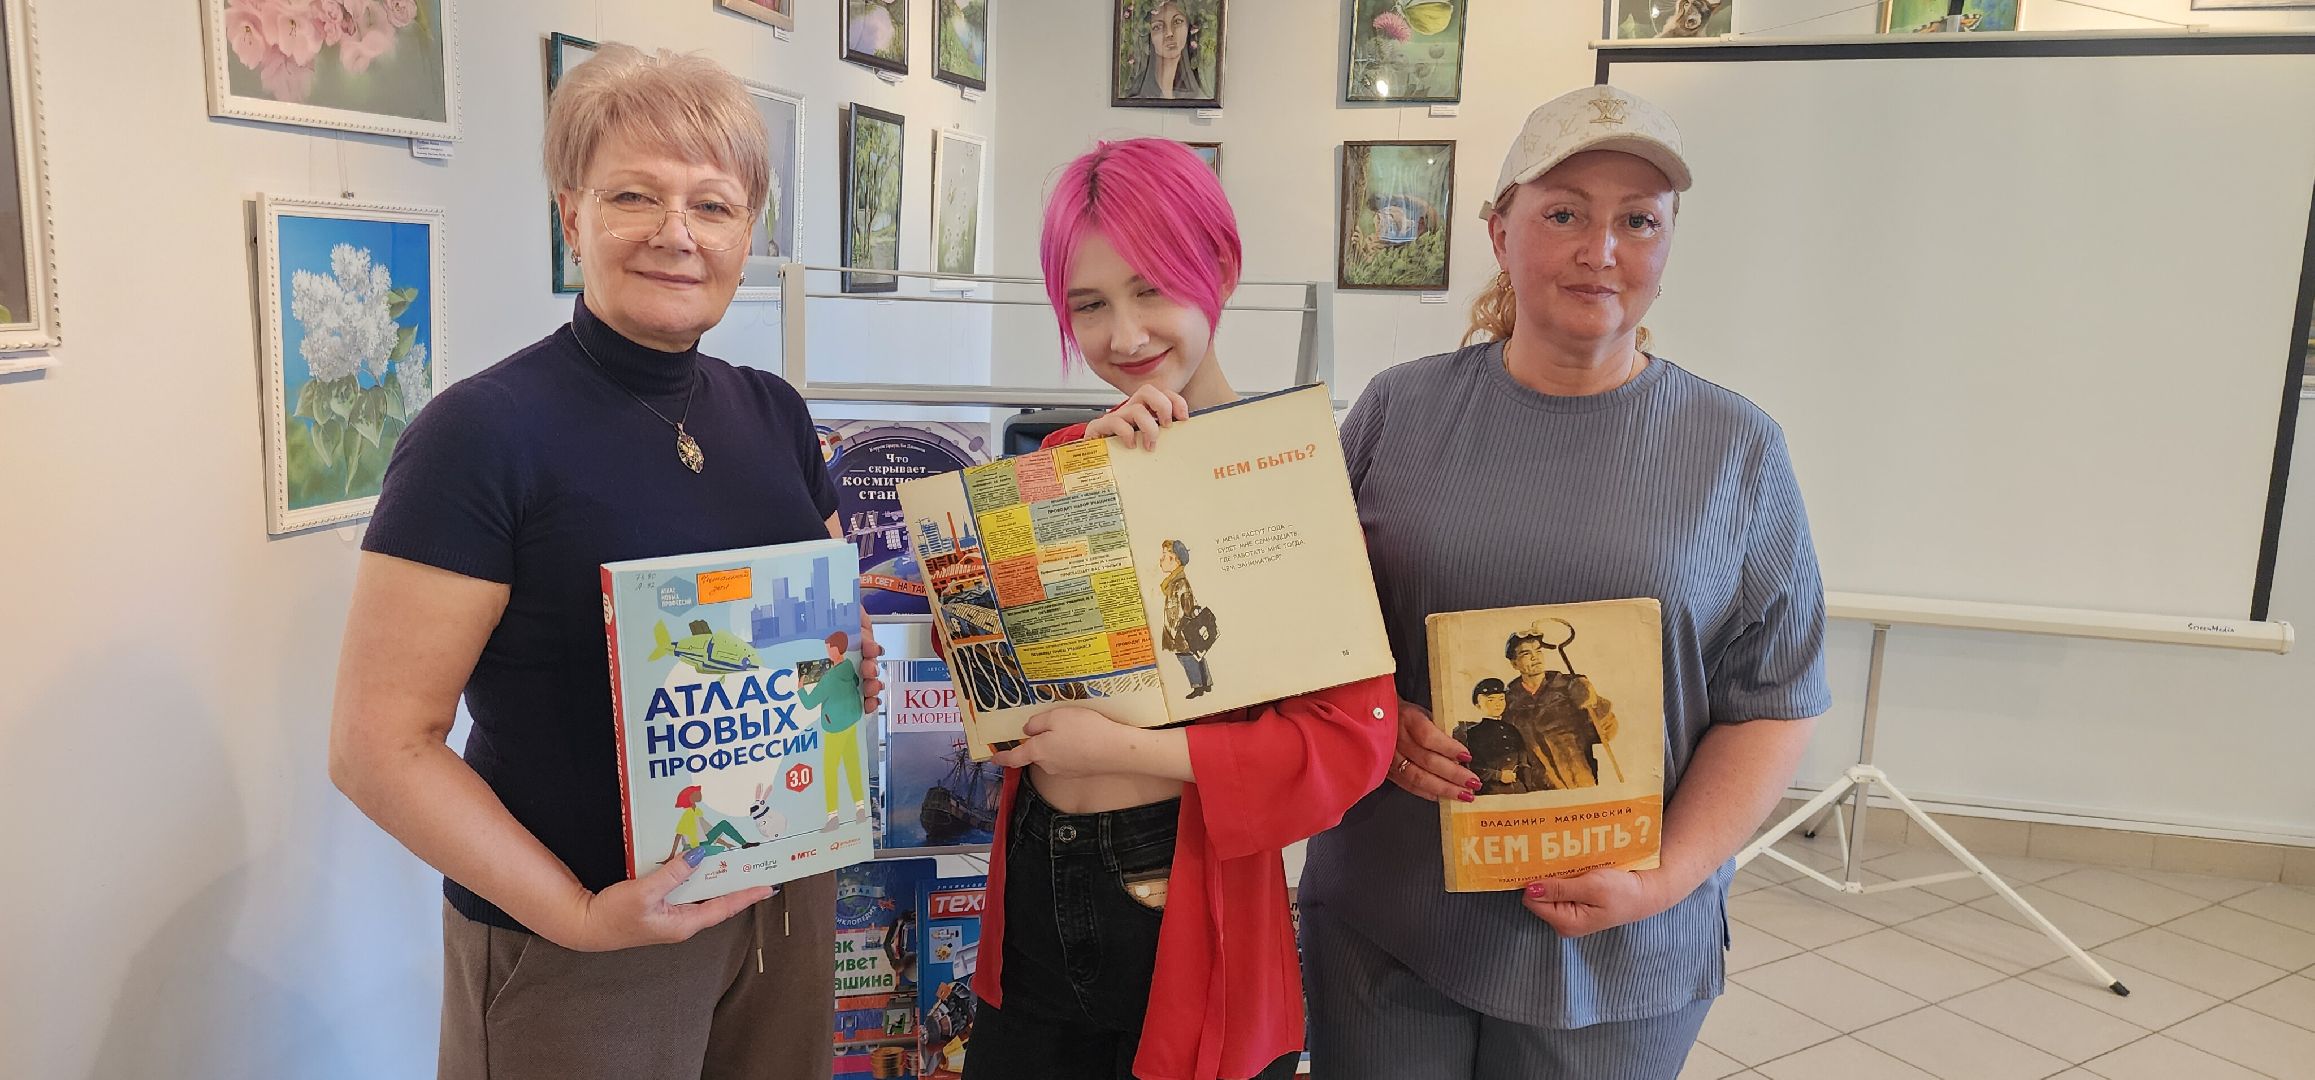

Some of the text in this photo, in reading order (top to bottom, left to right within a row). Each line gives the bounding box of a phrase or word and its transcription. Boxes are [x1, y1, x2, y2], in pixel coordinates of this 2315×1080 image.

[886, 453, 909, 463] Что
[1257, 443, 1316, 470] БЫТЬ?
[868, 465, 926, 475] скрывает
[842, 476, 920, 486] космиче
[859, 490, 900, 500] стан
[1268, 524, 1285, 532] ГОДА
[875, 577, 895, 587] СВЕТ
[897, 581, 908, 590] НА
[644, 668, 795, 721] АТЛАС
[904, 689, 959, 708] КОР
[897, 712, 963, 724] И МОРЕП
[646, 703, 799, 754] НОВЫХ
[649, 728, 818, 779] ПРОФЕССИЙ
[789, 768, 810, 788] 3.0
[1480, 806, 1632, 828] ВЛАДИМИР МАЯКОВСКИЙ
[1461, 816, 1651, 865] КЕМ БЫТЬ?
[797, 849, 817, 860] МТС
[839, 887, 870, 896] ЕРВАЯ
[836, 905, 877, 925] ИКЛОПЕДИЯ
[835, 940, 854, 953] ак
[835, 957, 878, 971] ивет
[835, 974, 893, 991] ашина
